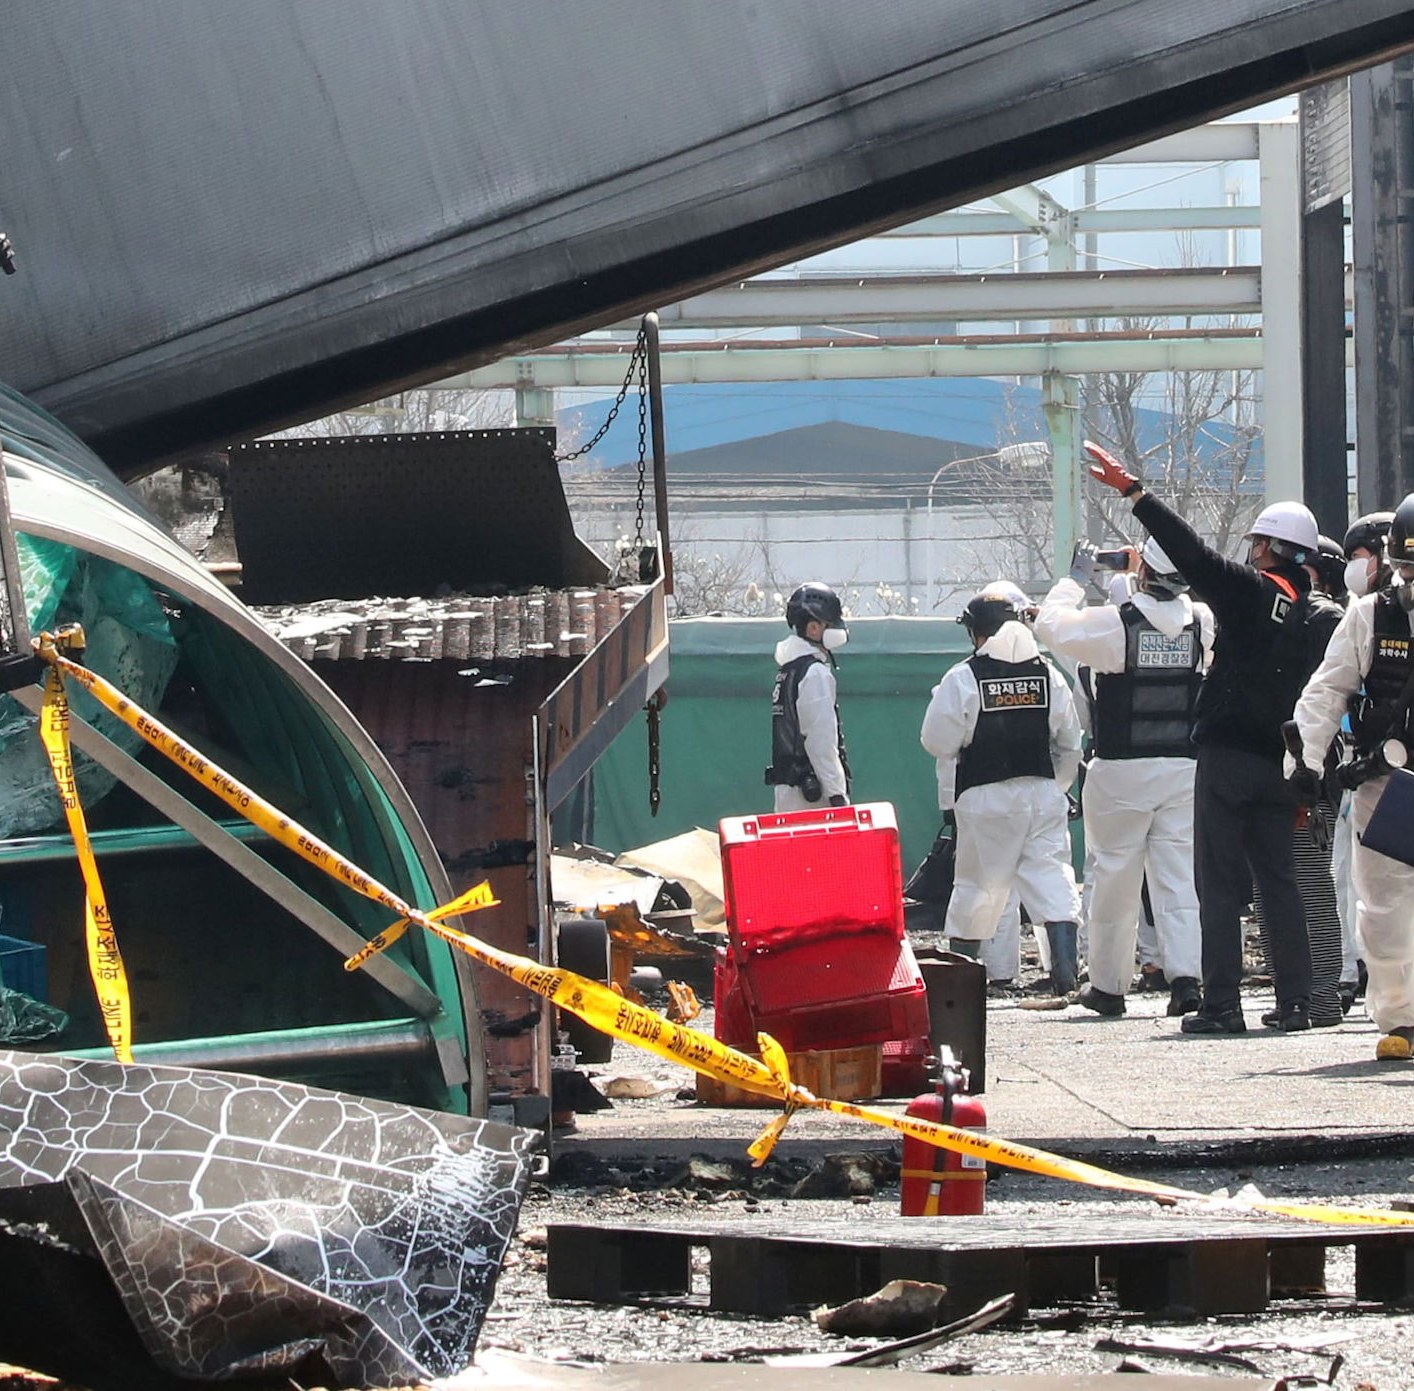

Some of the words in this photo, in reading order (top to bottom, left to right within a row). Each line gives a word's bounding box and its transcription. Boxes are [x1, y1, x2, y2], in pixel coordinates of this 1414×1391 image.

[1379, 649, 1408, 658] 과학수사
[988, 680, 1041, 696] 화재감식
[995, 693, 1037, 707] POLICE
[101, 997, 121, 1028] LINE
